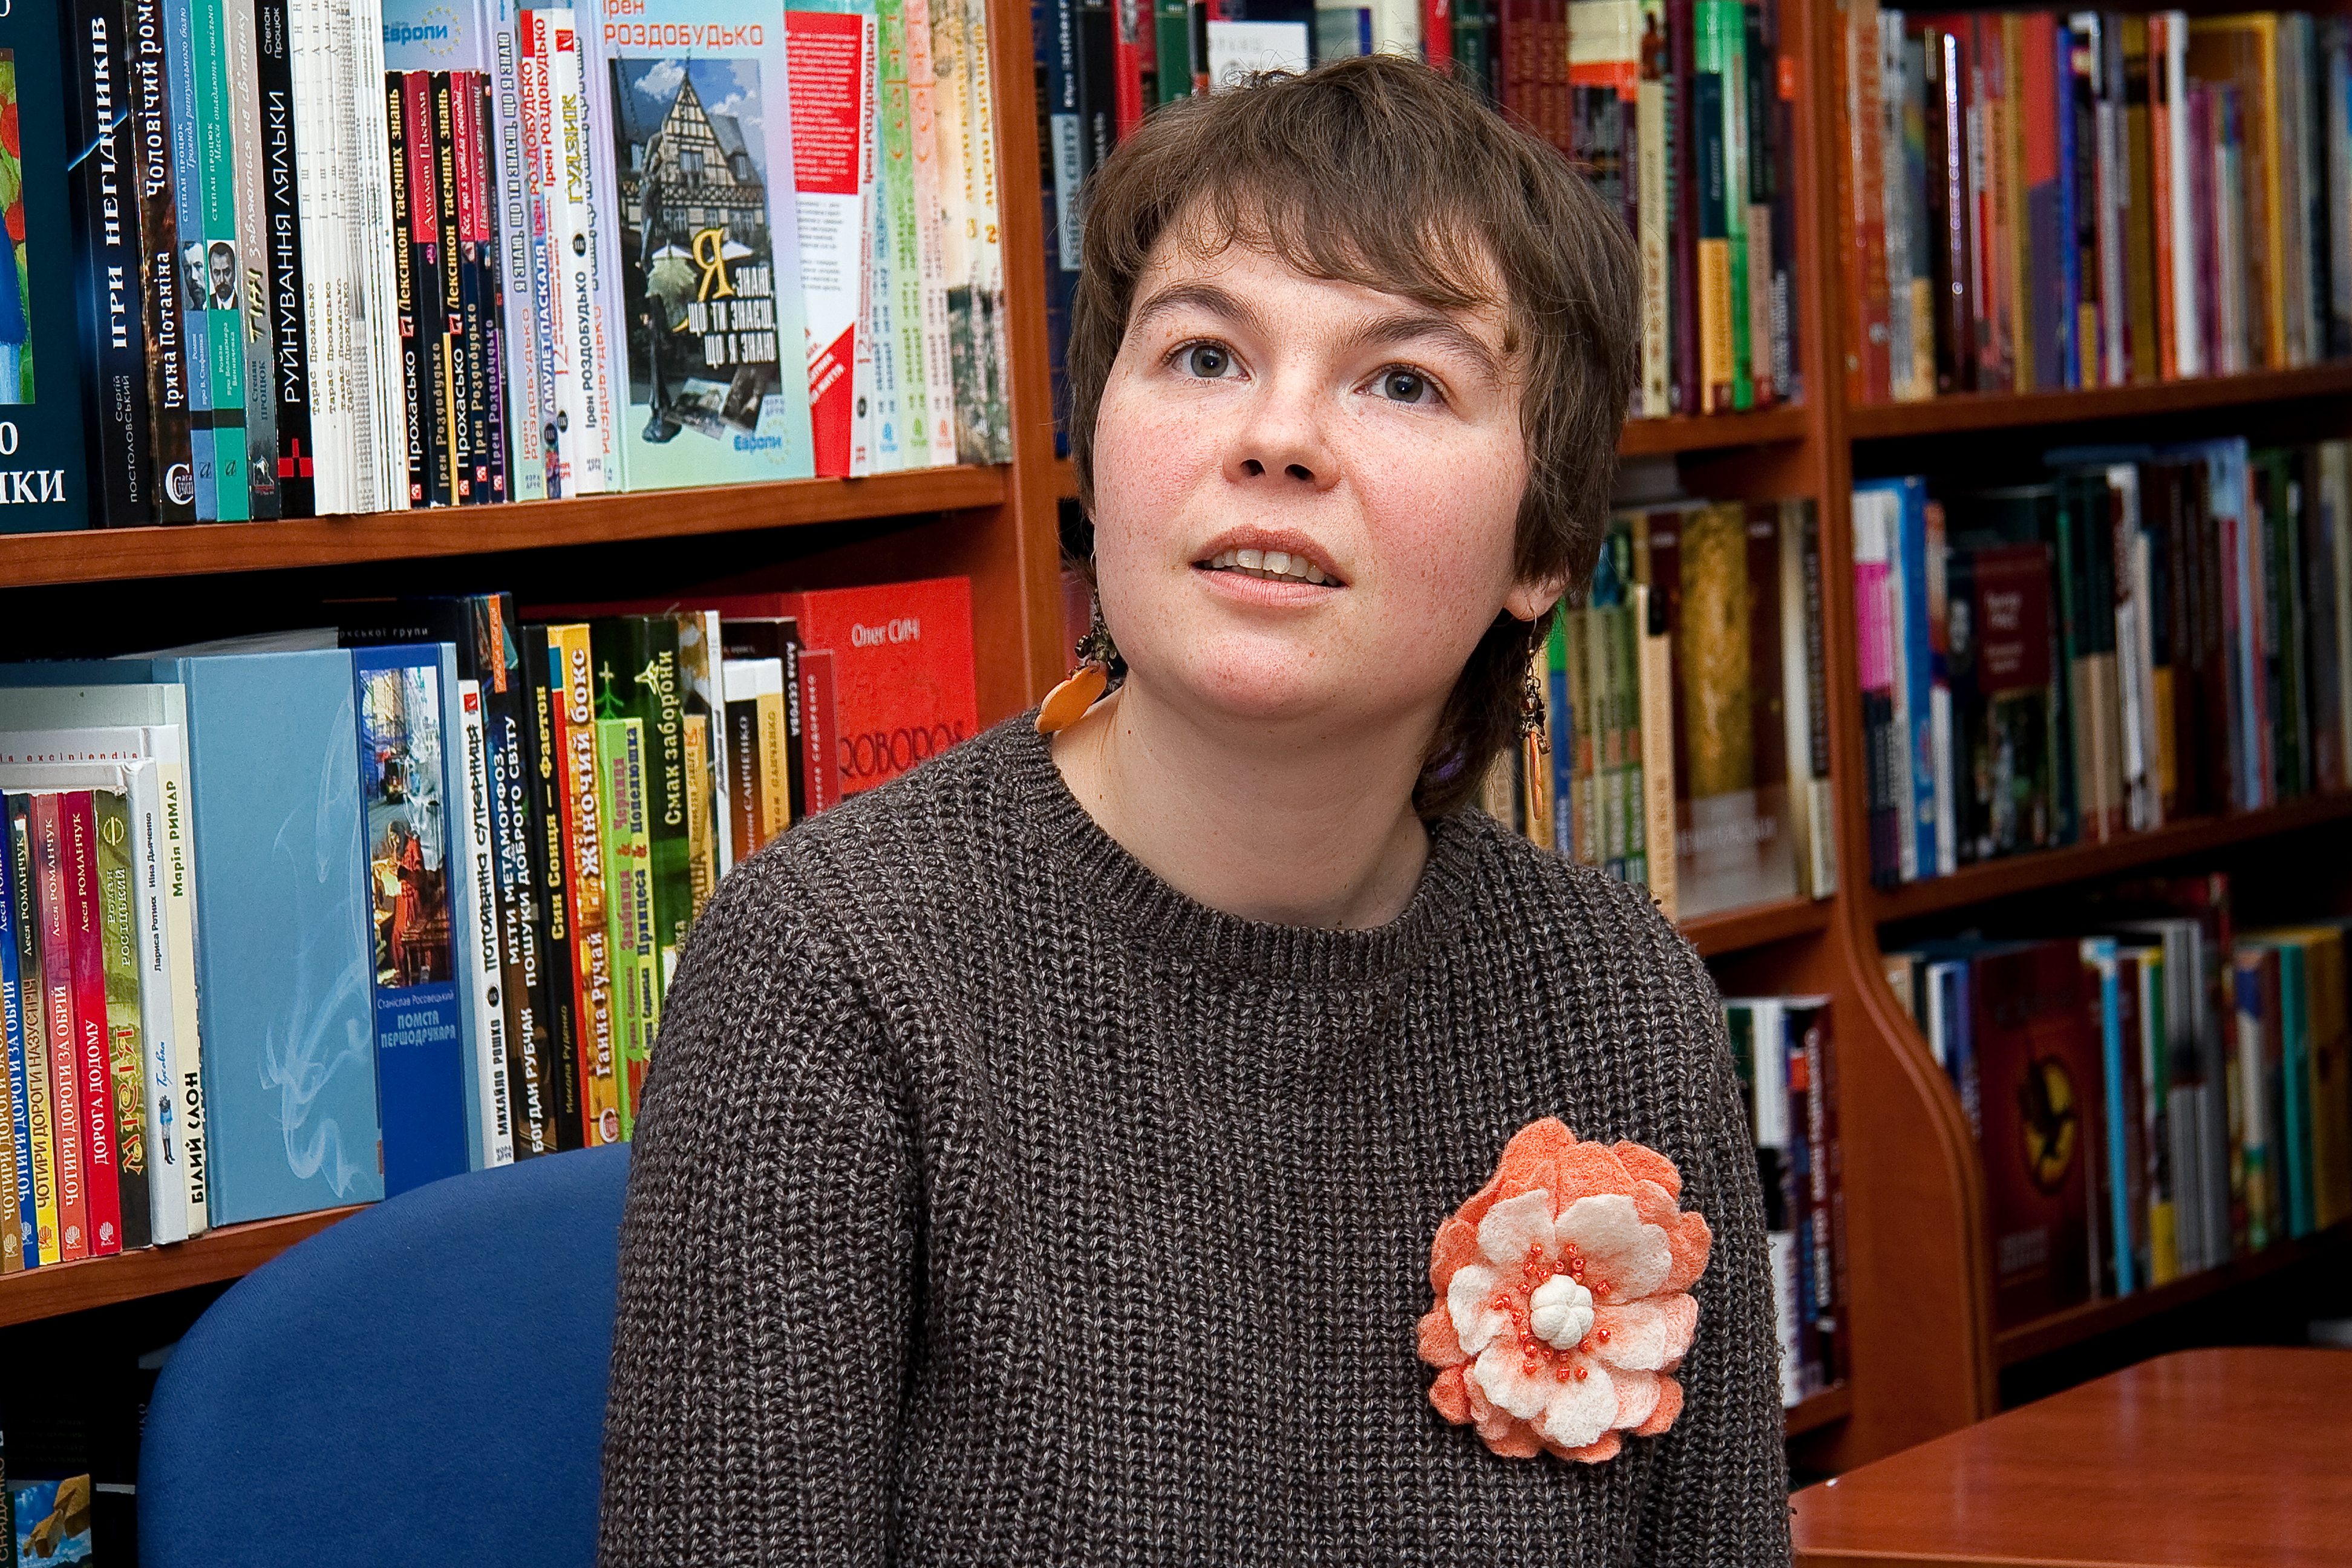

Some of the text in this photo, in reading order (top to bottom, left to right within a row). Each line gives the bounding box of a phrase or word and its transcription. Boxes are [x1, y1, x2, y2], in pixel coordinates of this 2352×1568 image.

[237, 11, 250, 103] світанку
[263, 7, 273, 54] Степан
[272, 7, 283, 59] Процюк
[603, 0, 645, 20] Ірен
[604, 24, 763, 50] РОЗДОБУДЬКО
[136, 0, 165, 197] Чоловічий ром
[182, 42, 194, 120] ритуального
[207, 5, 222, 163] Маски опадають повільно
[243, 109, 252, 134] на
[534, 18, 552, 145] РОЗДОБУДЬКО
[91, 17, 128, 349] ІГРИ НЕГІДНИКІВ
[177, 123, 186, 173] ПРОЦЮК
[185, 121, 195, 170] Троянда
[419, 91, 434, 231] Амулет Паскаля
[497, 32, 527, 293] Я ЗНАЮ, ЩО ТИ ЗНАЄШ, ЩО Я ЗНАЮ
[544, 149, 556, 187] Ірен
[269, 91, 301, 403] РУЙНУВАННЯ ЛЯЛЬКИ
[389, 88, 423, 471] Прохасько Лексикон таємних знань
[438, 88, 471, 468] Прохасько Лексикон таємних знань
[521, 61, 555, 413] АМУЛЕТ ПАСКАЛЯ Ірен РОЗДОБУДЬКО
[676, 227, 734, 327] Я
[733, 266, 774, 298] ЗНАЮ,
[153, 252, 184, 409] Ірина Потаніна
[307, 283, 320, 416] Тарас Прохасько
[325, 281, 336, 414] Тарас Прохасько
[342, 281, 354, 413] Тарас Прохасько
[553, 344, 569, 374] 12
[575, 272, 593, 391] РОЗДОБУДЬКО
[687, 298, 776, 338] ЩО ТИ ЗНАЄШ,
[704, 332, 776, 370] ЩО Я ЗНАЮ
[113, 375, 124, 422] Сергій
[122, 374, 138, 502] ПОСТОЛОВСЬКИЙ
[258, 360, 269, 421] ПРОЦЮК
[432, 342, 449, 488] Ірен Роздобудько
[467, 304, 487, 455] Ірен Роздобудько
[485, 319, 501, 466] Ірен Роздобудько
[522, 308, 538, 460] РОЗДОБУДЬКО
[585, 396, 596, 428] Ірен
[393, 627, 429, 639] групи
[852, 622, 886, 647] Олег
[570, 648, 600, 878] Жіночий бокс
[613, 758, 630, 831] Черниця
[626, 727, 642, 834] Попелюшка
[657, 651, 682, 825] Смак заборони
[73, 812, 89, 933] Леся РОМАНЧУК
[166, 780, 184, 897] Марія РИМАР
[494, 746, 520, 965] МІТИ МЕТАМОРФОЗ,
[505, 715, 537, 987] ПОШУКИ ДОБРОГО СВІТУ
[536, 686, 565, 940] Син Сонця Фаетон
[16, 837, 32, 956] Леся РОМАНЧУК
[45, 817, 60, 938] Леся РОМАНЧУК
[106, 869, 117, 924] Роман
[636, 869, 653, 956] Принцеса
[153, 933, 162, 972] Лариса
[377, 998, 411, 1010] Станіслав
[587, 932, 611, 1076] Ганна Ручай
[381, 1024, 456, 1048] ПЕРШОДРУКАРА
[397, 1010, 440, 1030] ПОМСТА
[490, 1019, 508, 1136] МИХАЙЛО РОШКО
[8, 1035, 30, 1201] ЧОТИРИ ДОРОГИ ЗА
[23, 978, 50, 1208] ЧОТИРИ ДОРОГИ НАЗУСТРІЧ
[51, 985, 78, 1207] ЧОТИРИ ДОРОГИ ЗА ОБРІЙ
[86, 1019, 109, 1165] ДОРОГА ДОДОМУ
[184, 1072, 204, 1204] БІЛИЙ СЛОН
[521, 1007, 544, 1154] БОГДАН РУБЧАК
[1, 1151, 16, 1221] ЧОТИРИ
